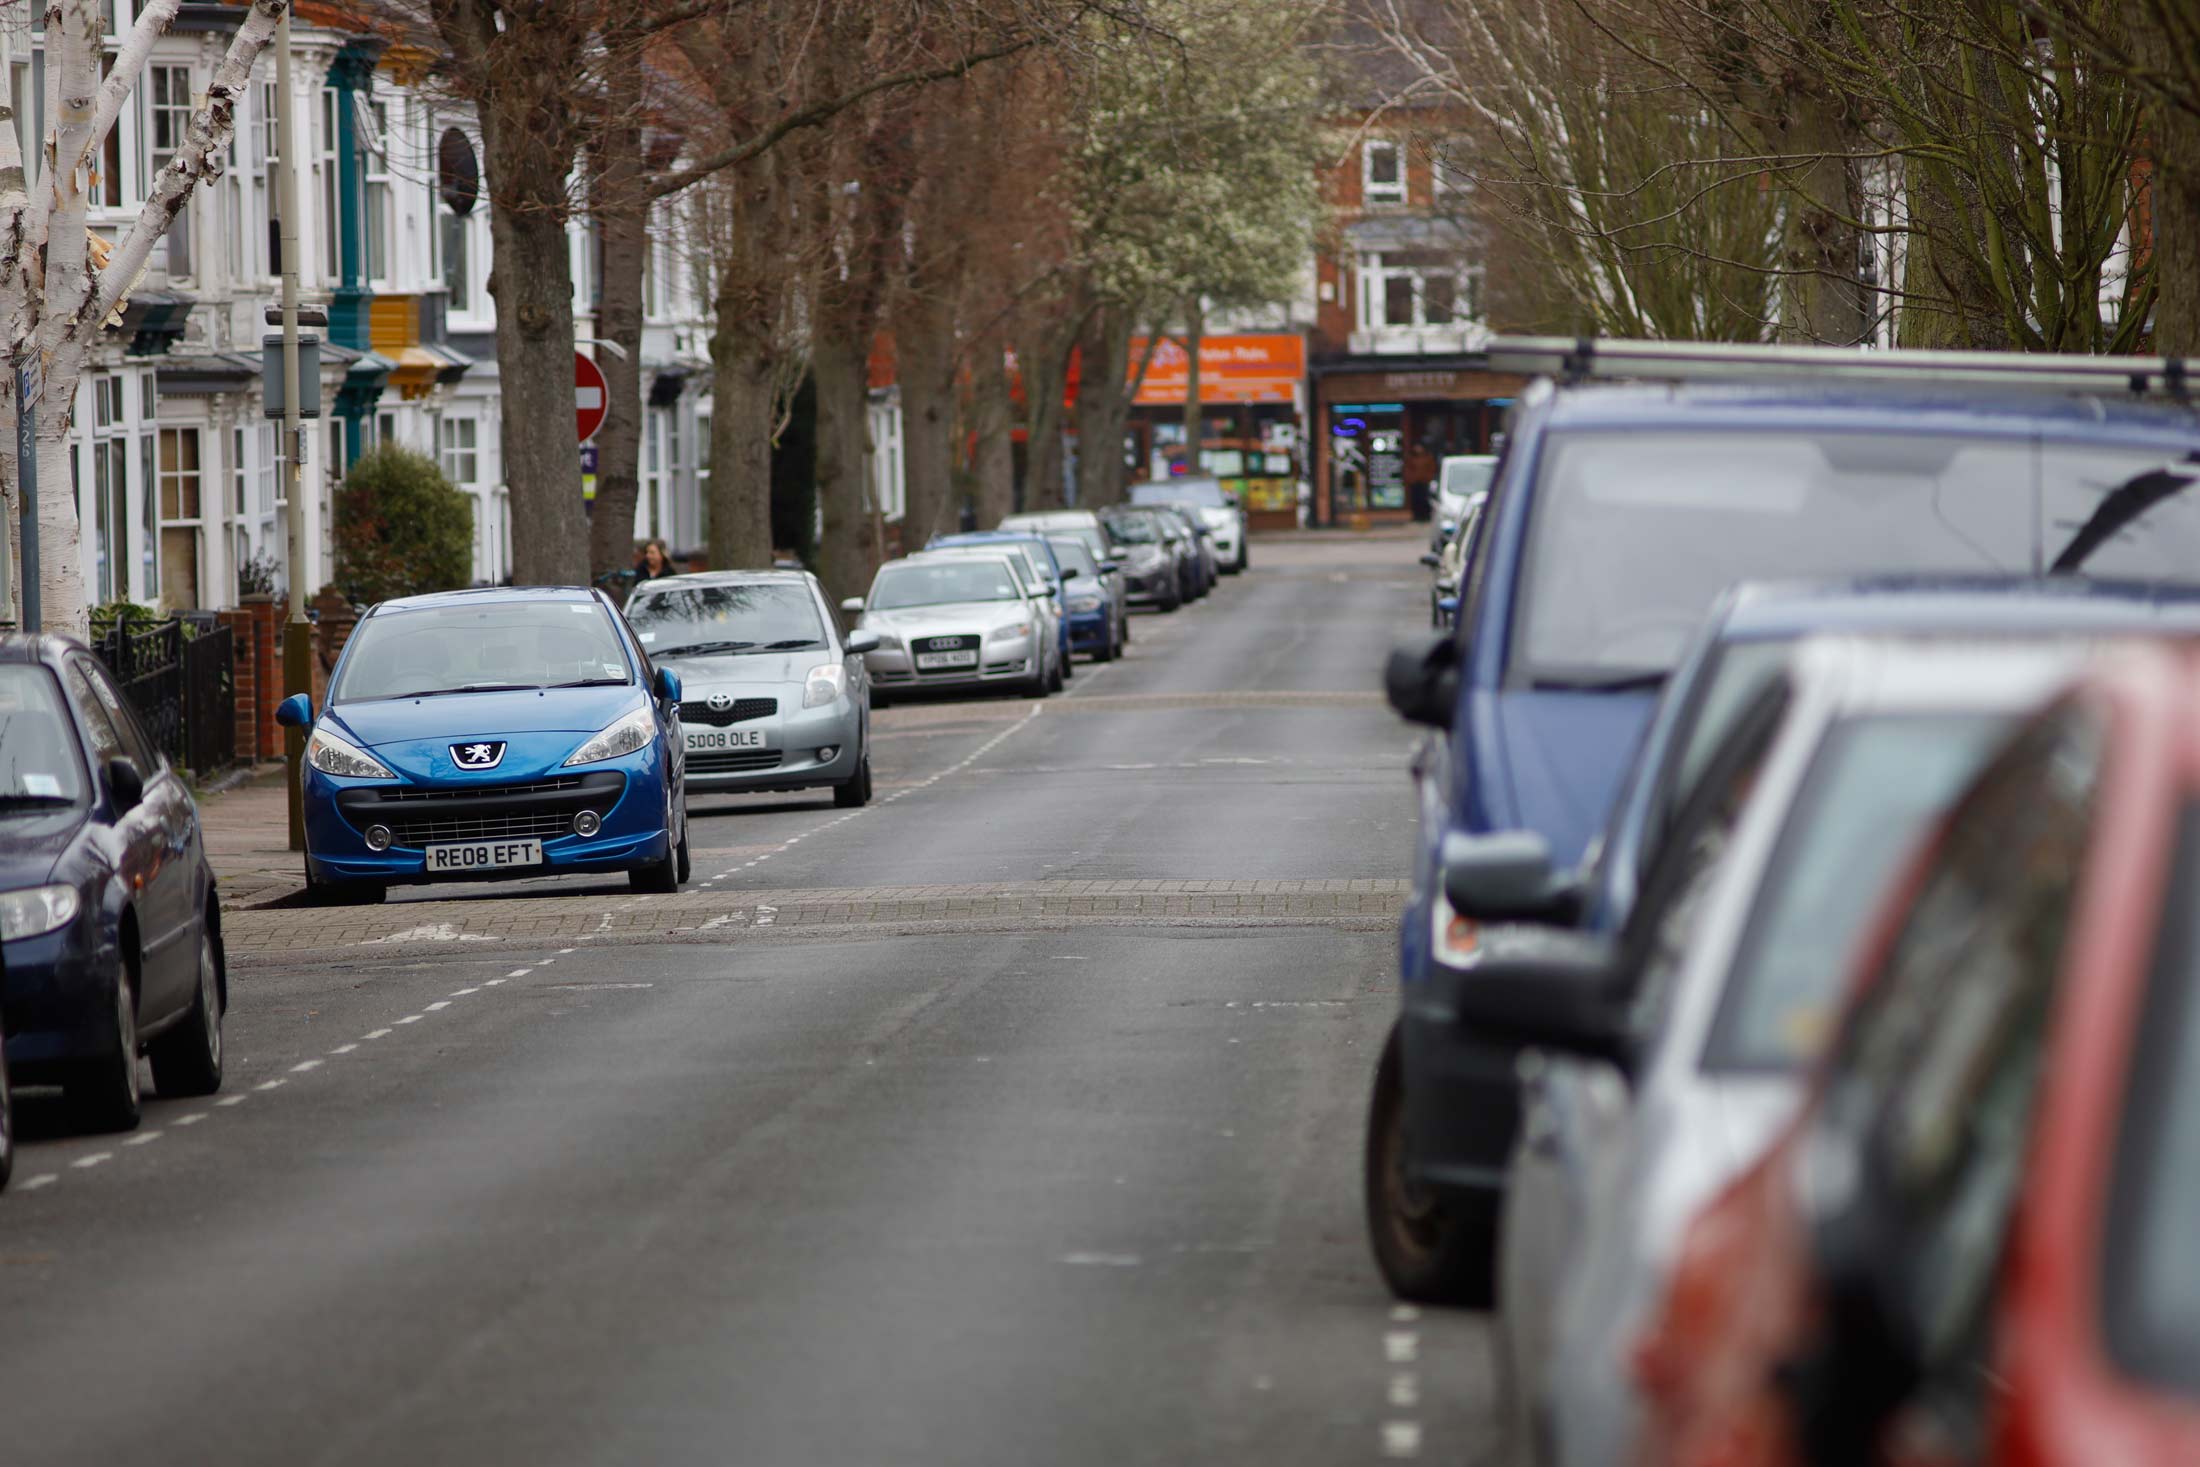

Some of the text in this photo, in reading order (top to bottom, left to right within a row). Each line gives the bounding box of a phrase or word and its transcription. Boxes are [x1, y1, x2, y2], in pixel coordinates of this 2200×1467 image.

[686, 731, 759, 749] SD08 OLE
[435, 843, 533, 868] RE08 EFT
